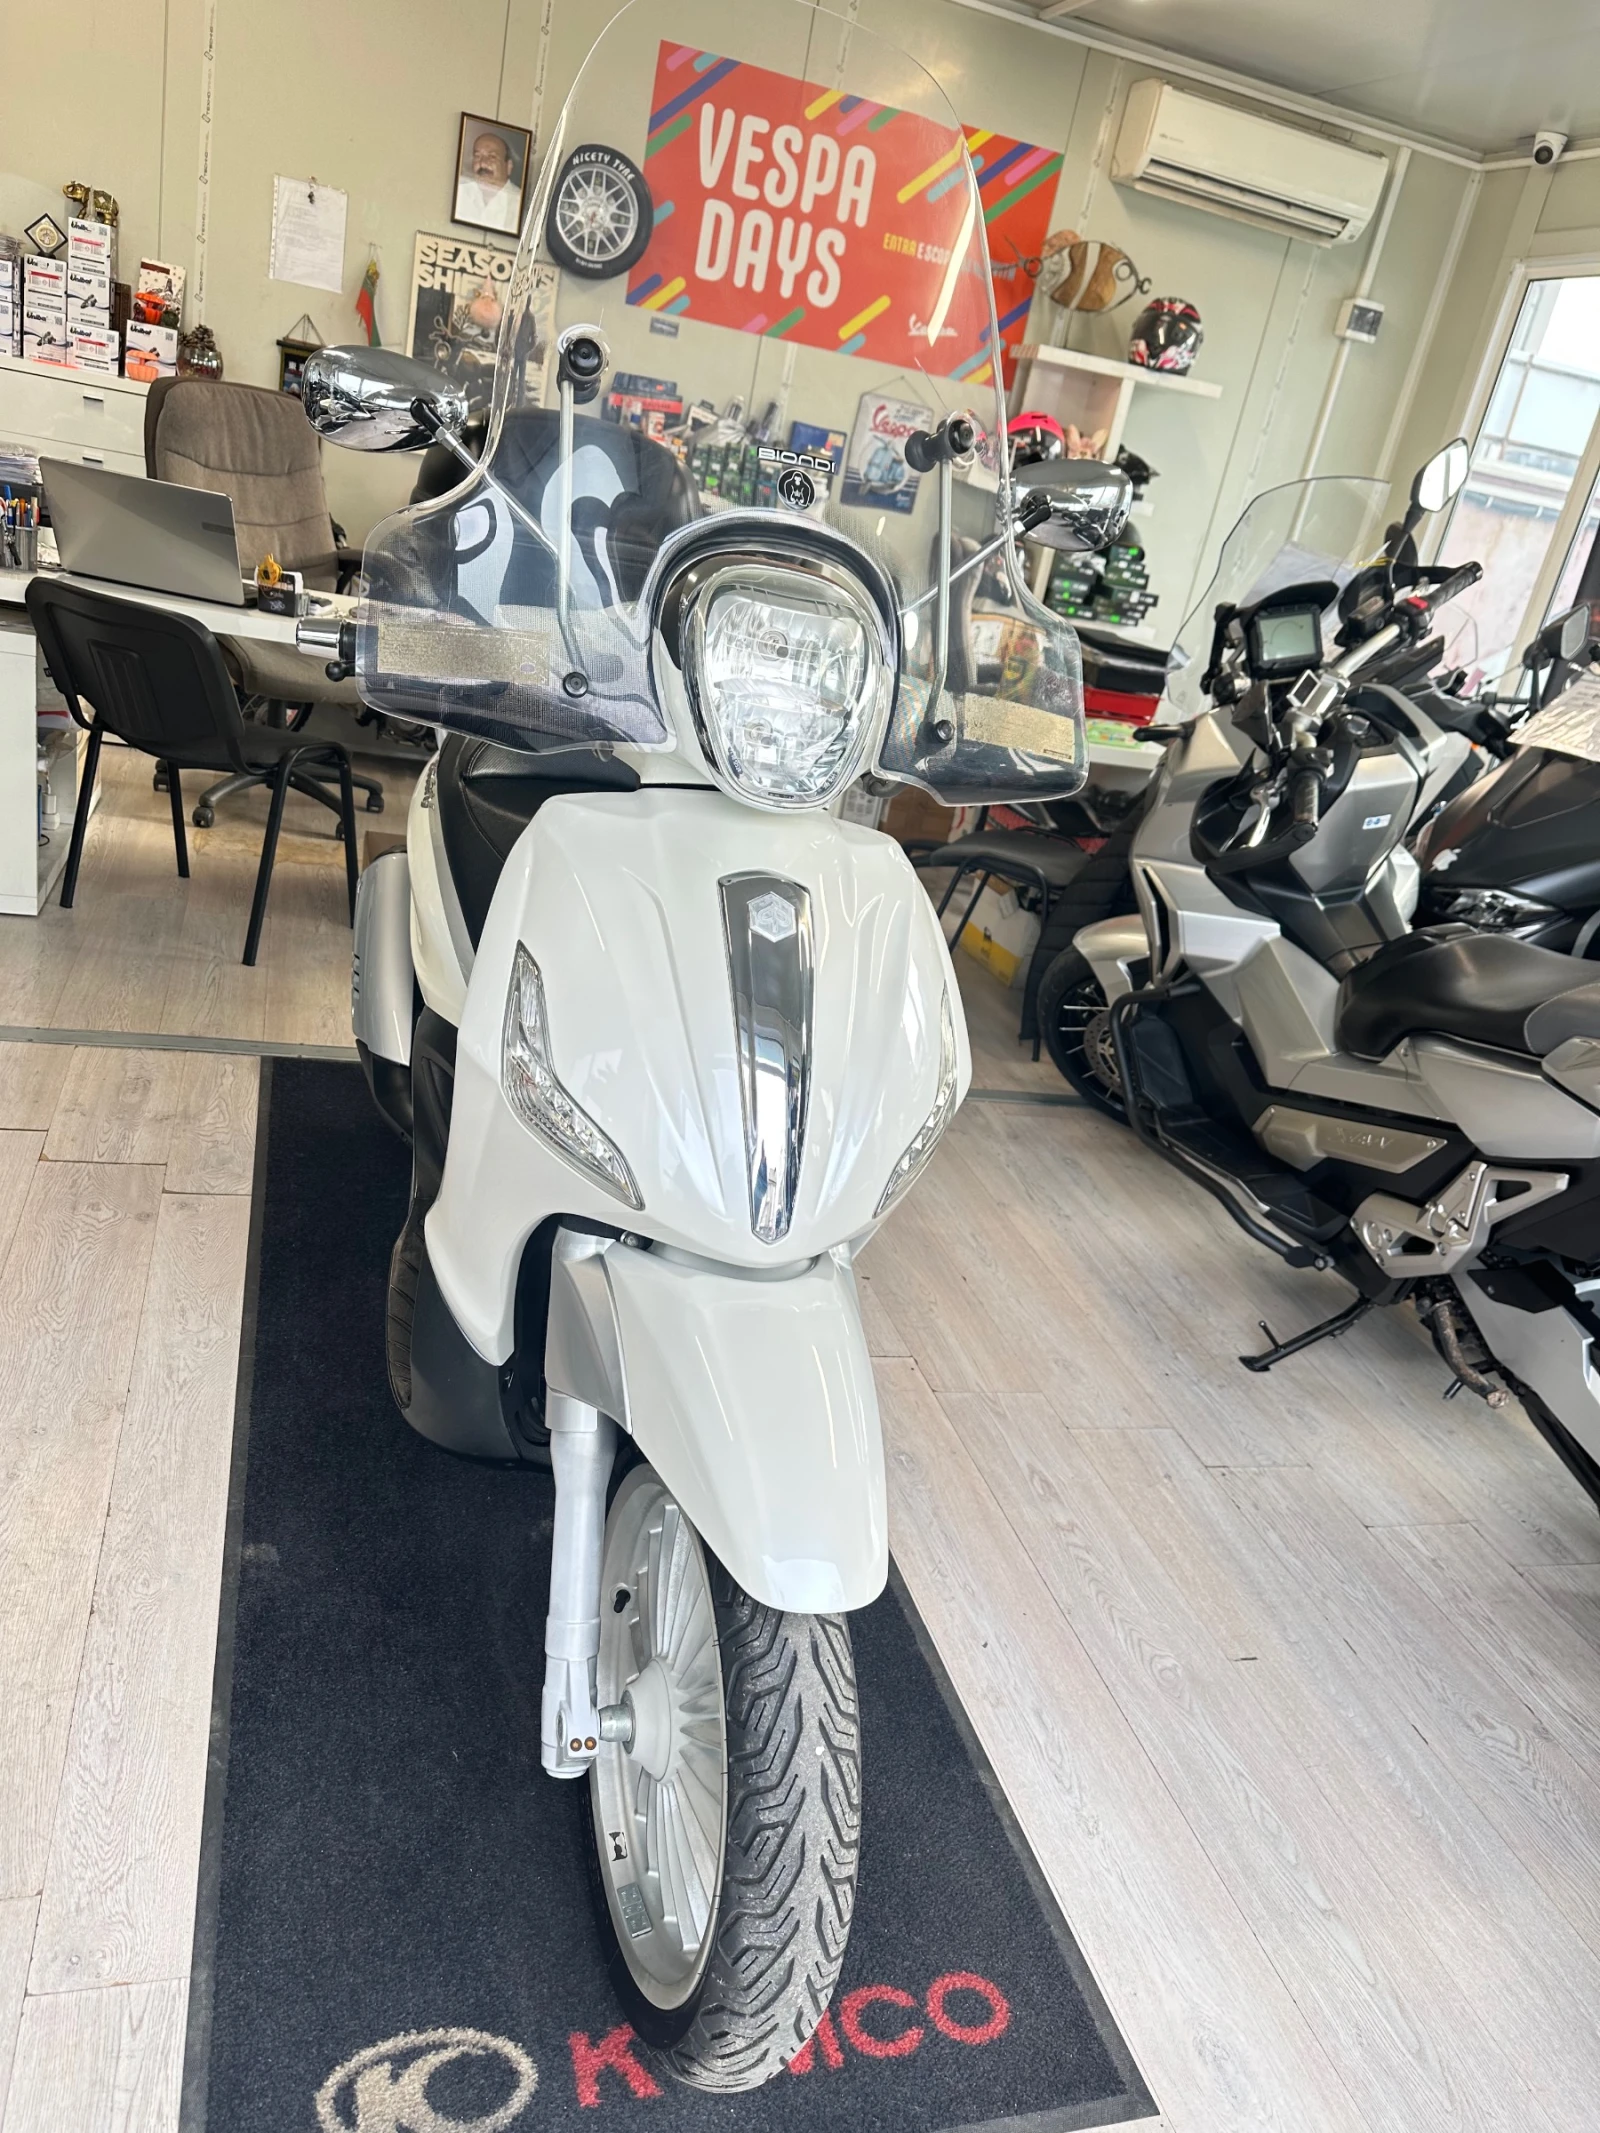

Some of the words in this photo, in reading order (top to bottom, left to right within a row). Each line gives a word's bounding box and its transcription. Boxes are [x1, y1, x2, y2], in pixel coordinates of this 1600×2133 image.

[572, 151, 611, 166] NICETY
[612, 158, 636, 181] TYRE
[699, 102, 876, 228] VESPA
[694, 198, 846, 308] DAYS
[758, 447, 836, 473] BIONDI
[568, 1972, 1010, 2107] KCO
